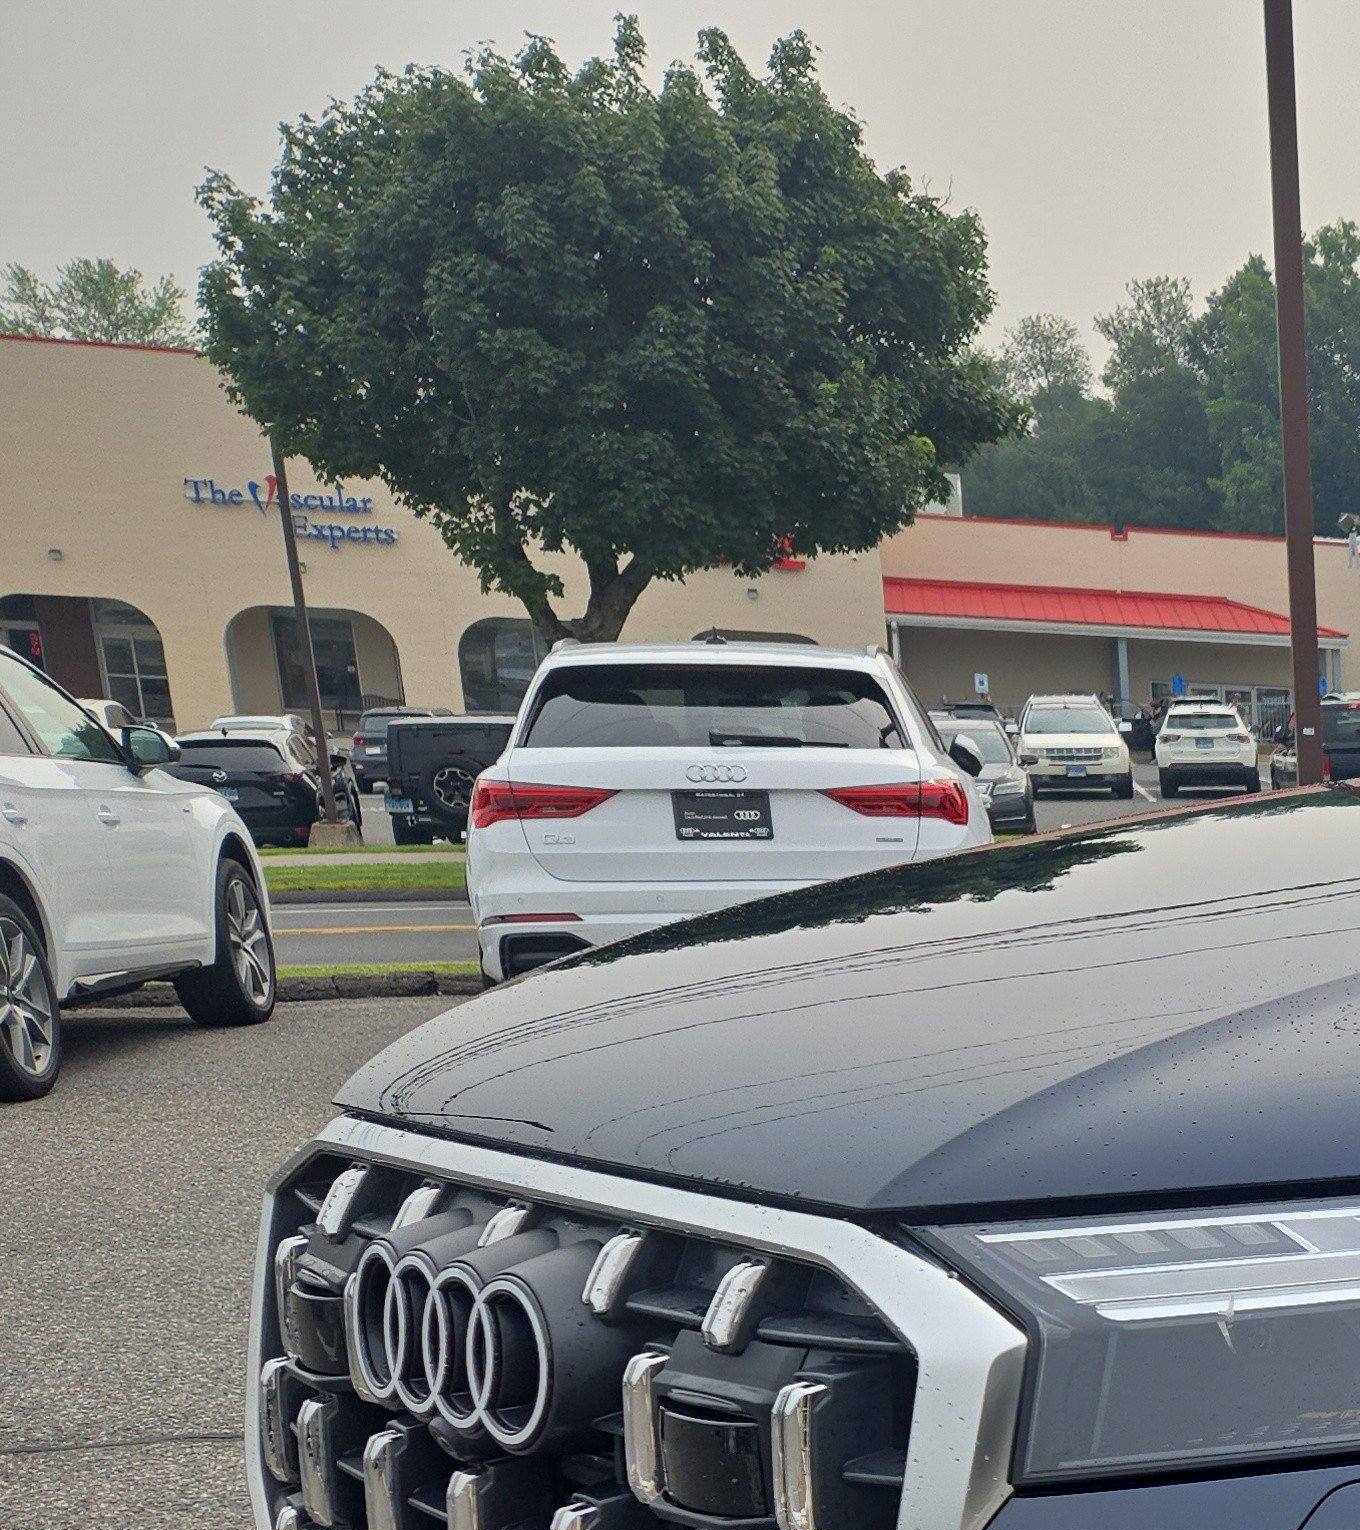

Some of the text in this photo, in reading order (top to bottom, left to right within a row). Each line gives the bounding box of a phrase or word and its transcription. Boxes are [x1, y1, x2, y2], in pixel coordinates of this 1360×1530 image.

[184, 475, 373, 518] The Vscular
[290, 515, 398, 550] Experts
